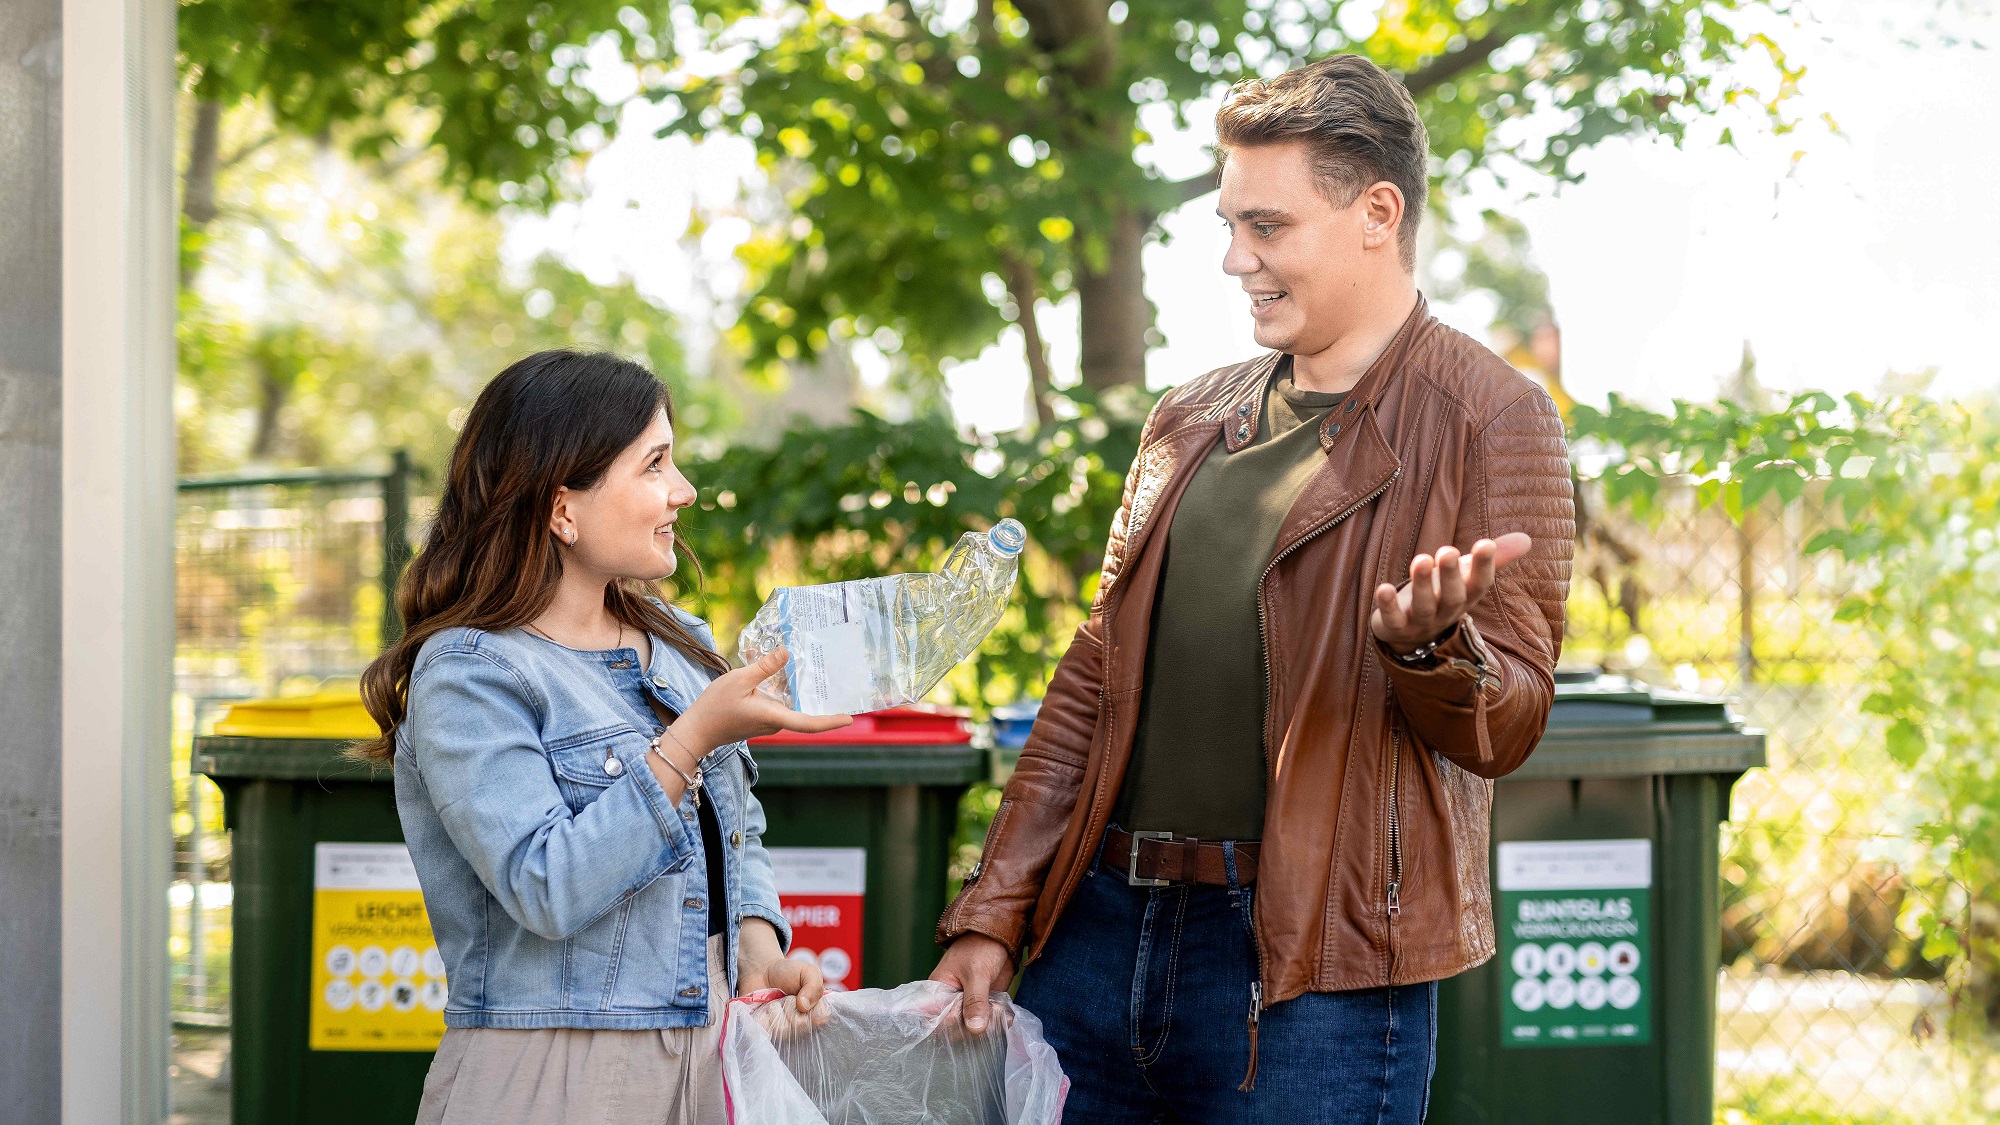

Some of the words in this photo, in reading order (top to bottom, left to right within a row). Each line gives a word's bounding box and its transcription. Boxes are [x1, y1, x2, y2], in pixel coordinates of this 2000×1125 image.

[356, 902, 422, 920] LEICHT
[782, 905, 841, 927] APIER
[1518, 898, 1632, 922] BUNTGLAS
[1512, 919, 1639, 938] VERPACKUNGEN
